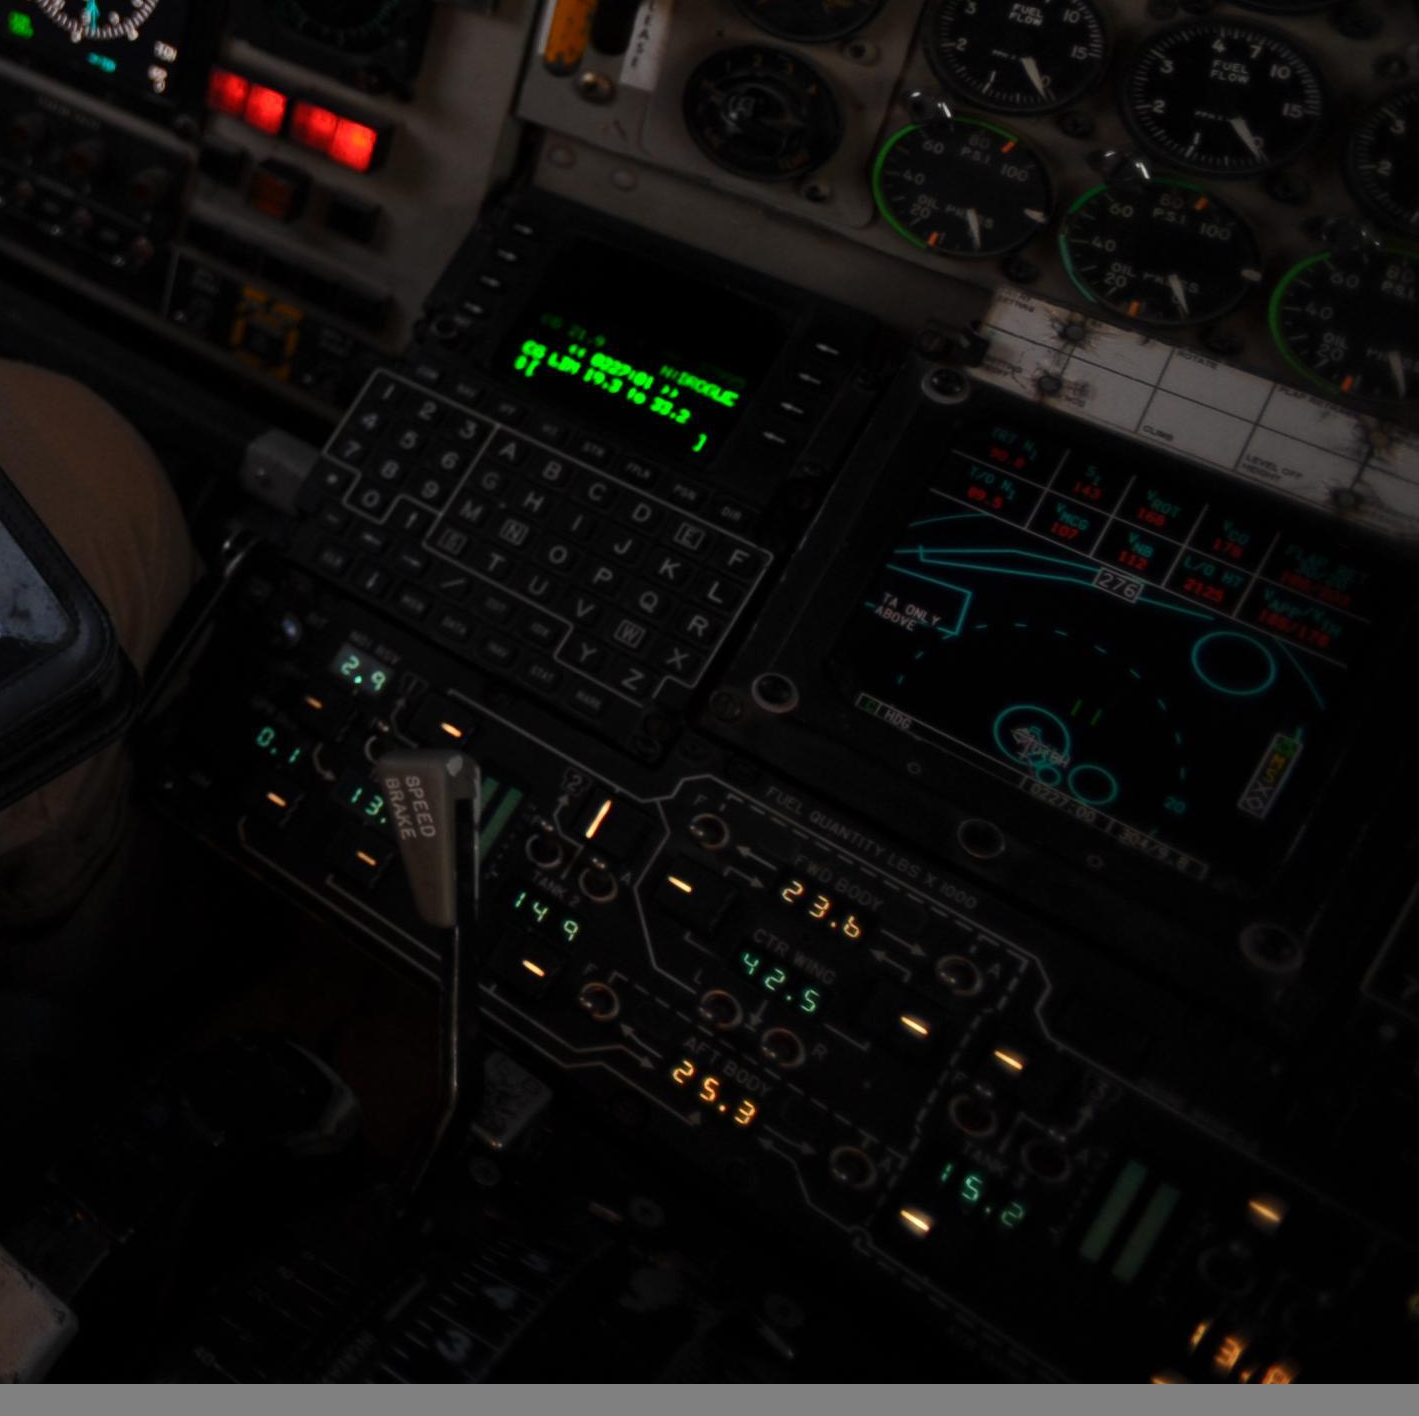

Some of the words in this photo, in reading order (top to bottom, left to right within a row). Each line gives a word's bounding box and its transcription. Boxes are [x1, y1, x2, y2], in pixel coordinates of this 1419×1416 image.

[1008, 11, 1043, 28] FLOW
[1013, 2, 1043, 18] FUEL
[1062, 8, 1082, 24] 10
[1208, 68, 1252, 85] FLOW
[1213, 59, 1249, 75] FUEL
[1270, 64, 1292, 80] 10
[1000, 164, 1030, 183] 100
[916, 193, 939, 210] OIL
[1198, 222, 1232, 242] 100
[1110, 260, 1136, 278] OIL
[1322, 331, 1350, 351] OIL
[418, 400, 437, 421] 2
[460, 419, 478, 439] 3
[344, 439, 362, 458] 7
[498, 442, 516, 461] A
[380, 459, 400, 480] 8
[441, 451, 459, 470] 6
[542, 460, 562, 481] B
[421, 480, 439, 499] 9
[482, 472, 500, 490] G
[363, 488, 381, 508] 0
[523, 491, 545, 512] H
[588, 483, 607, 501] C
[460, 500, 484, 521] M
[631, 503, 651, 522] D
[549, 545, 567, 565] O
[614, 539, 634, 555] J
[485, 553, 506, 572] T
[727, 549, 750, 567] F
[593, 567, 613, 585] P
[659, 557, 681, 580] K
[529, 576, 548, 595] U
[708, 581, 723, 604] L
[1096, 570, 1138, 599] 276
[576, 600, 595, 619] V
[639, 590, 659, 613] Q
[882, 592, 899, 608] TA
[904, 604, 943, 628] ONLY
[686, 614, 709, 635] R
[873, 605, 917, 633] ABOVE
[579, 642, 597, 662] Y
[667, 648, 689, 670] X
[341, 654, 387, 692] 2.9
[621, 668, 645, 690] Z
[882, 709, 913, 731] HDG
[255, 725, 302, 764] 0.1
[385, 777, 416, 840] BRAKE
[405, 775, 437, 838] SPEED
[765, 784, 804, 816] FUEL
[807, 809, 885, 860] QUANTITY
[886, 852, 922, 882] LBS
[938, 881, 979, 911] 1000
[793, 853, 834, 886] FWD
[834, 876, 885, 913] BODY
[751, 927, 791, 957] CTR
[792, 950, 838, 986] WING
[736, 950, 822, 1016] 42.5
[682, 1035, 722, 1067] AFT
[721, 1063, 774, 1099] BODY
[671, 1058, 758, 1128] 25.3
[937, 1160, 1027, 1231] 15.2
